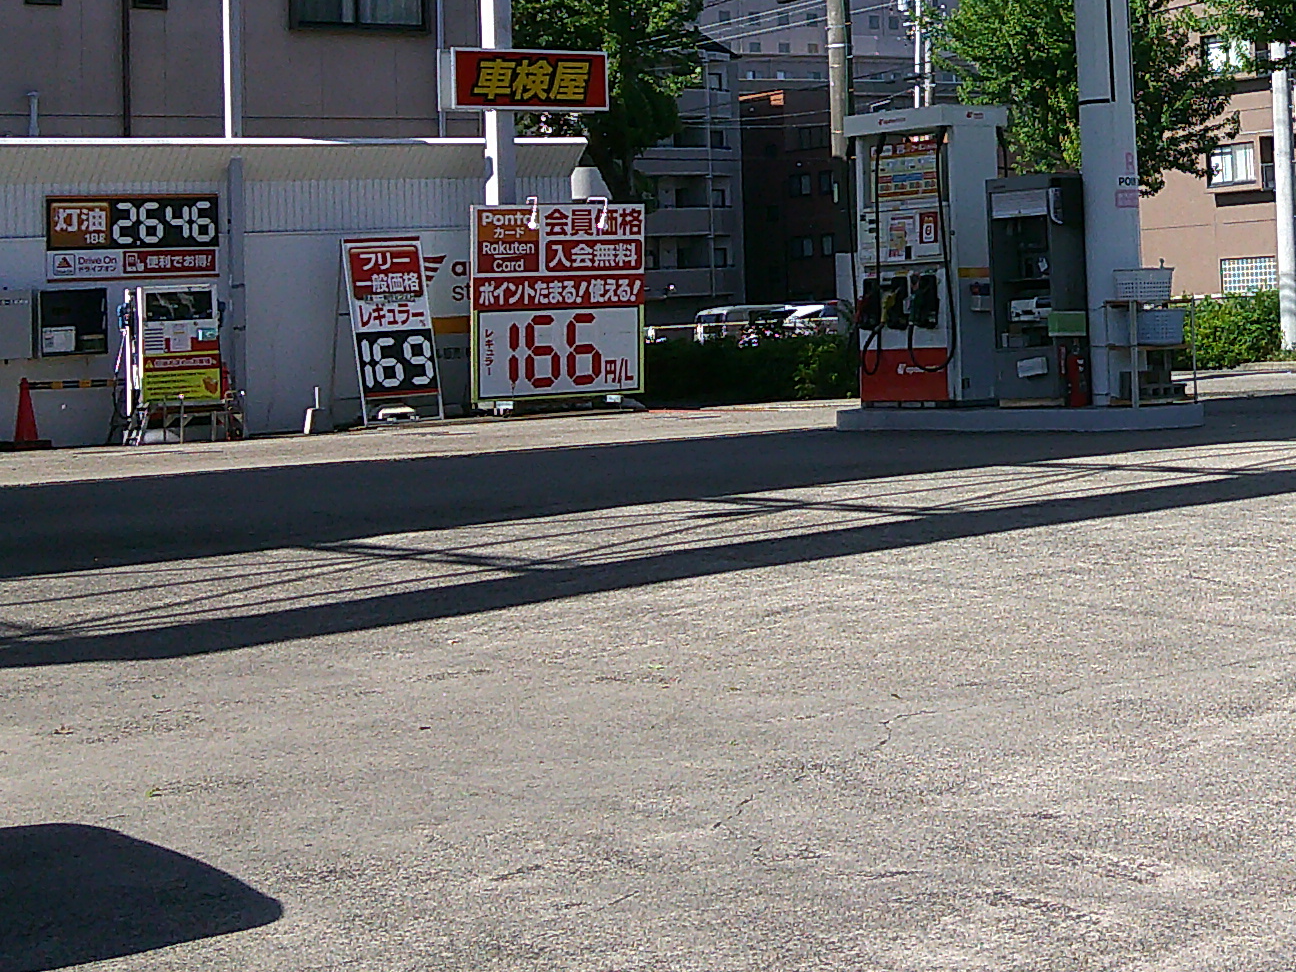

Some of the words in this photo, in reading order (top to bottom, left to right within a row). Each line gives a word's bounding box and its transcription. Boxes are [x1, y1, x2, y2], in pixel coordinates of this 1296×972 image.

[474, 58, 591, 101] 車検屋
[54, 209, 107, 232] 灯油
[544, 208, 642, 236] 会員価格
[493, 228, 524, 239] カード
[483, 241, 535, 255] Rakuten
[548, 243, 638, 267] 入会無料
[146, 255, 212, 269] 便利でお得!
[359, 252, 411, 271] フリー
[493, 259, 525, 272] Card
[355, 272, 420, 293] 一般価格
[359, 303, 425, 328] レギュラー
[361, 335, 434, 389] 169
[508, 313, 602, 389] 166
